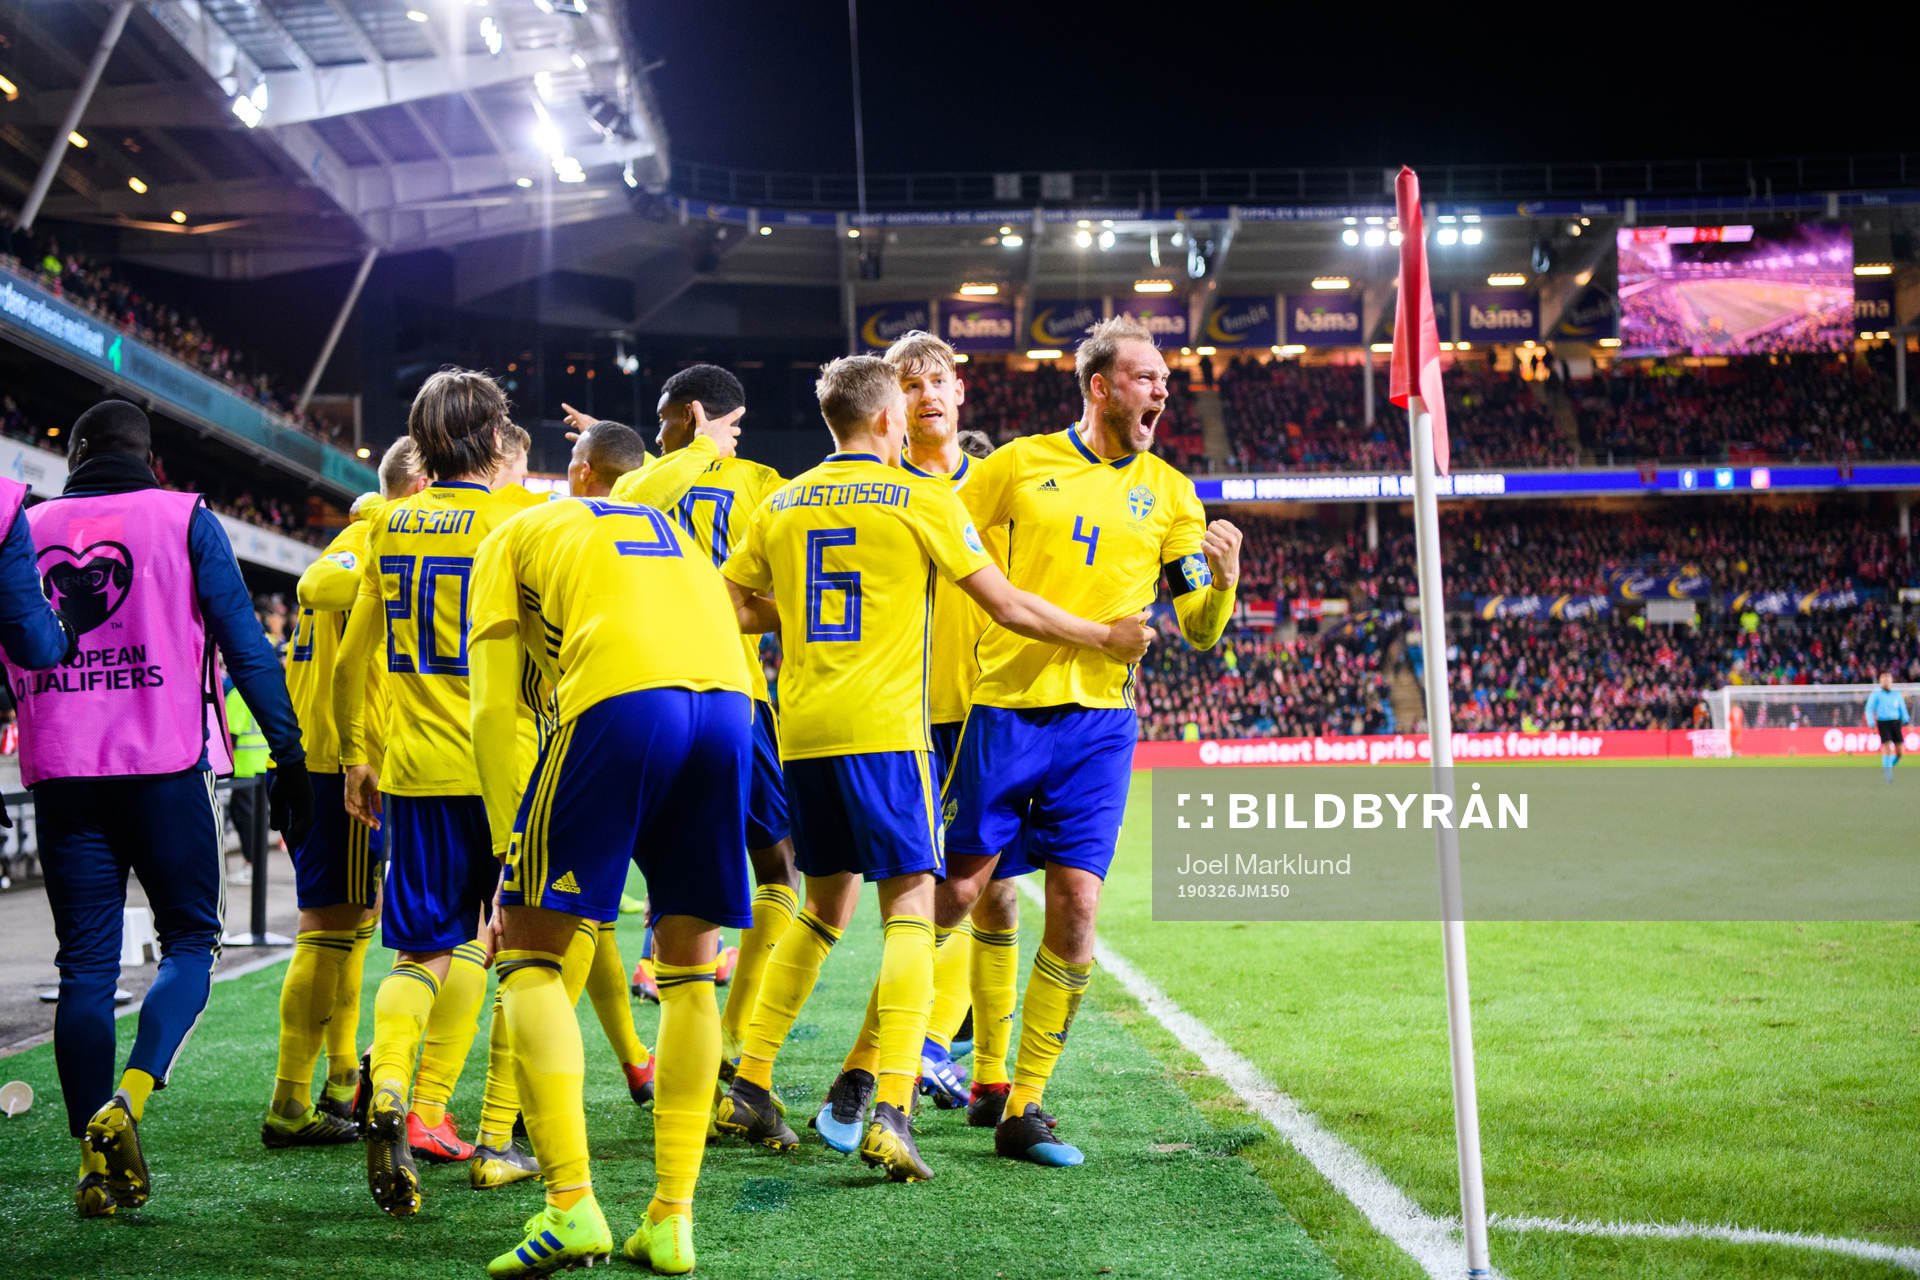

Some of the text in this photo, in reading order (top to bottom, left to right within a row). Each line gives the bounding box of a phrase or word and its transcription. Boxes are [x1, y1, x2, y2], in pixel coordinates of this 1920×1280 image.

[949, 312, 1013, 339] bama
[1295, 307, 1359, 333] bama
[1469, 304, 1534, 330] bama
[769, 483, 910, 513] AUGUSTINSSON
[387, 509, 476, 535] OLSSON
[1071, 515, 1101, 567] 4
[805, 526, 862, 644] 6
[379, 555, 475, 676] 20
[16, 665, 165, 703] QUALIFIERS
[1314, 736, 1368, 762] best
[1369, 735, 1416, 765] pris
[1506, 731, 1604, 757] fordeler
[551, 882, 581, 894] adidas
